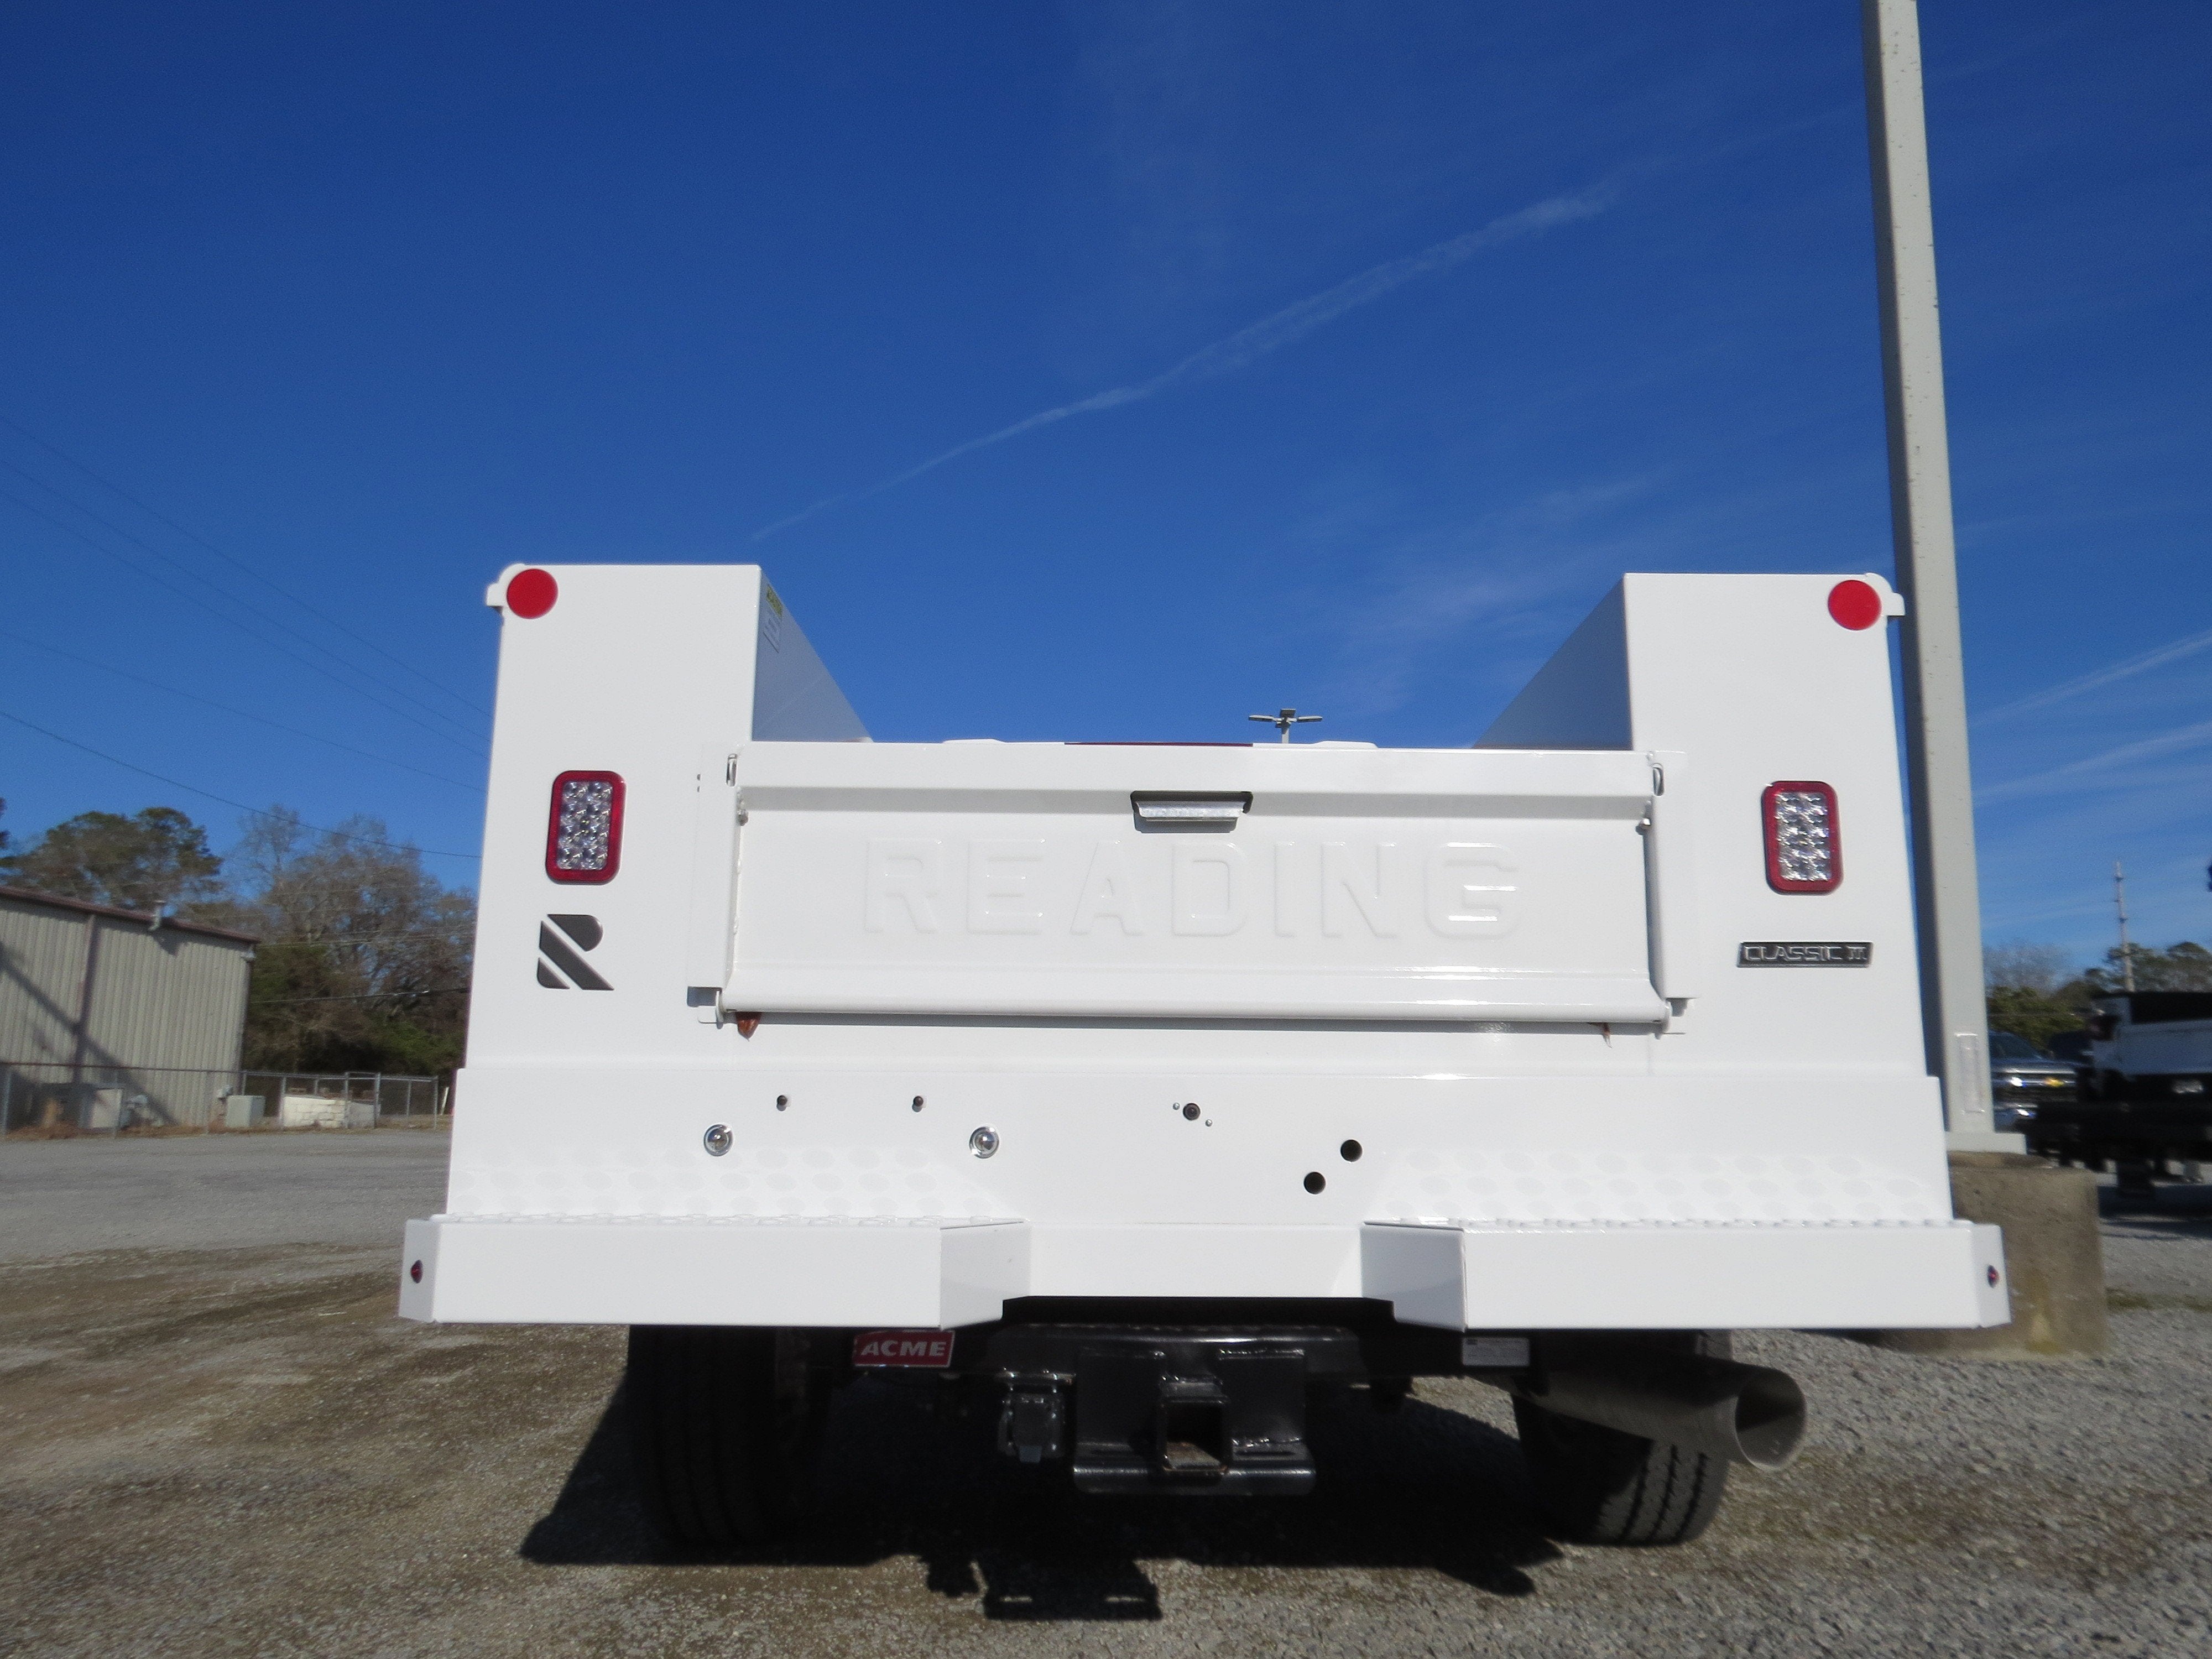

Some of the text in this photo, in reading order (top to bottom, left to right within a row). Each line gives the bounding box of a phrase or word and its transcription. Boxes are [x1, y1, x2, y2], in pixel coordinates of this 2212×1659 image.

[864, 838, 1520, 940] READING
[1744, 945, 1843, 961] CLASSIC
[860, 1340, 947, 1356] ACME
